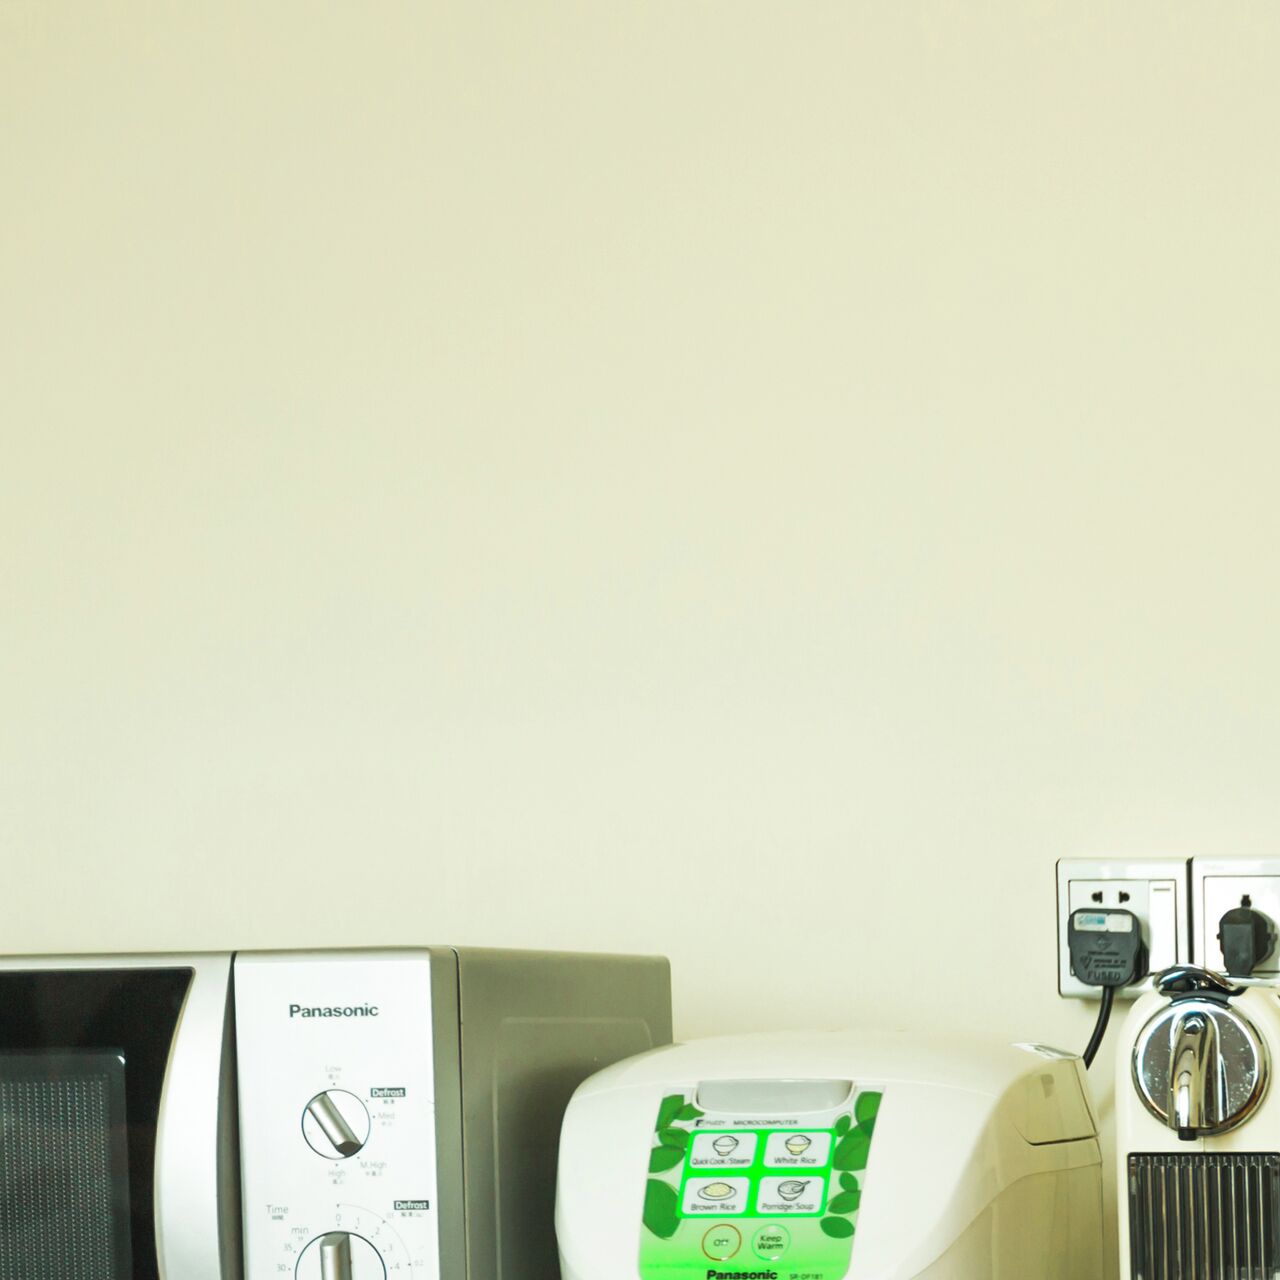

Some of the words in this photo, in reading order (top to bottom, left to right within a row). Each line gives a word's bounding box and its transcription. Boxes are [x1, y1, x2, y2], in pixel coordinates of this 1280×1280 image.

[288, 1002, 380, 1018] Panasonic
[371, 1088, 405, 1097] Defrost
[266, 1204, 289, 1214] Time
[394, 1201, 428, 1210] Defrost
[690, 1203, 717, 1211] Brown
[720, 1203, 736, 1211] Rice
[760, 1235, 782, 1243] Keep
[758, 1242, 784, 1250] Warm
[706, 1269, 778, 1280] Panasonic
